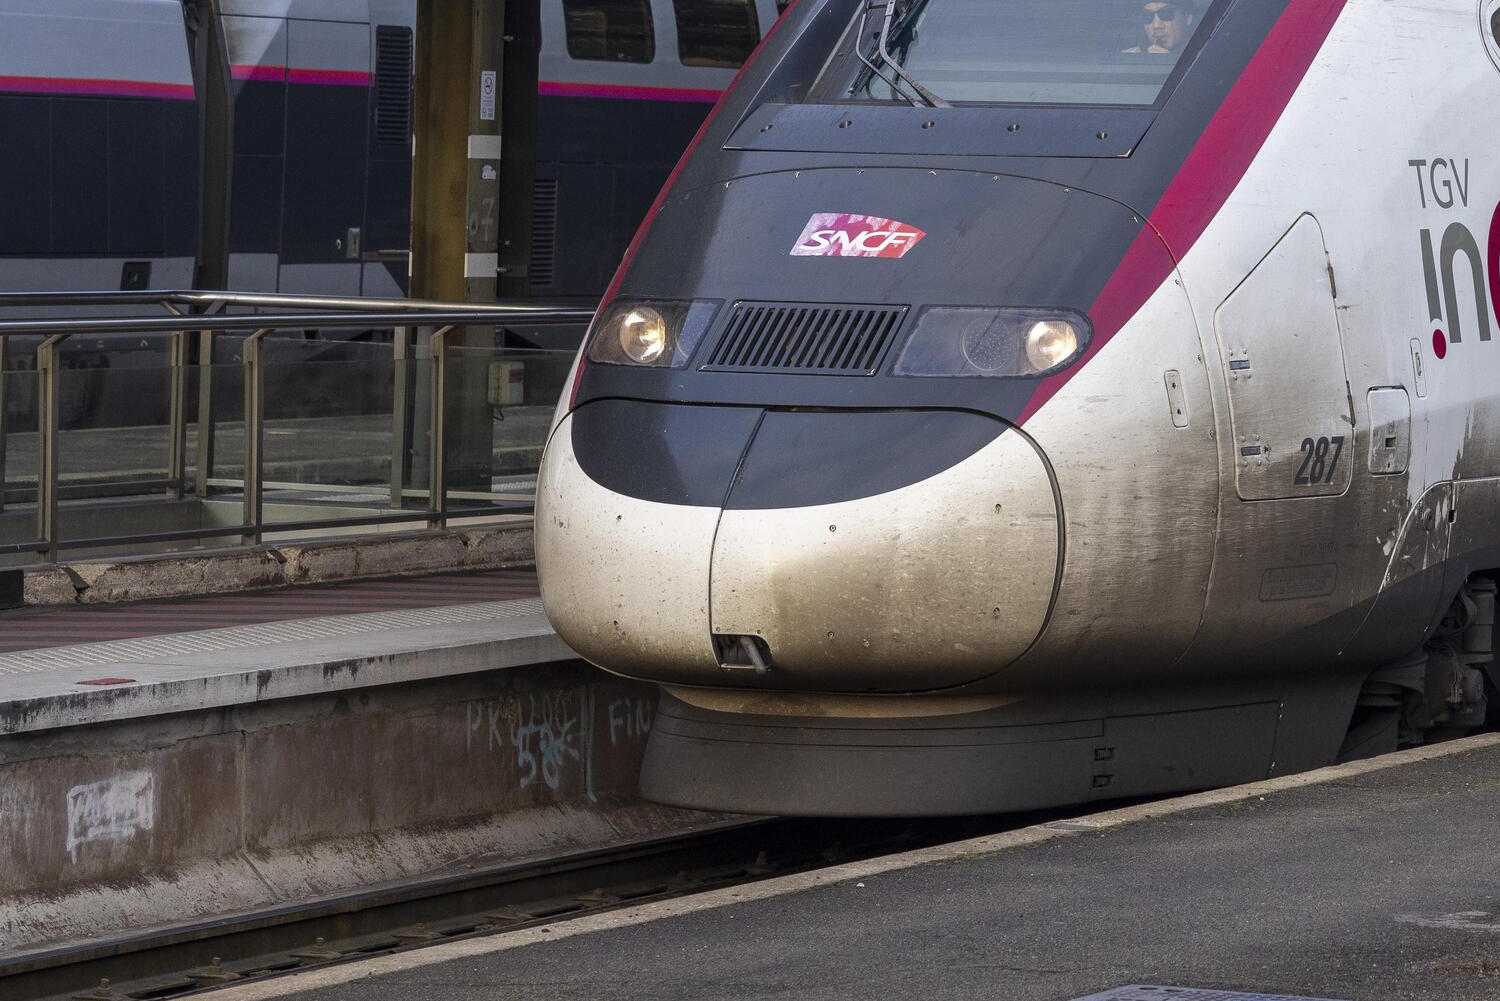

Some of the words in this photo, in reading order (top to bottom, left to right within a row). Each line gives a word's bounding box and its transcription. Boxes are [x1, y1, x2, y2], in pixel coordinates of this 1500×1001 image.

[1408, 158, 1469, 209] TGV
[798, 229, 918, 252] SNCF
[1294, 436, 1345, 485] 287
[466, 701, 503, 752] PK
